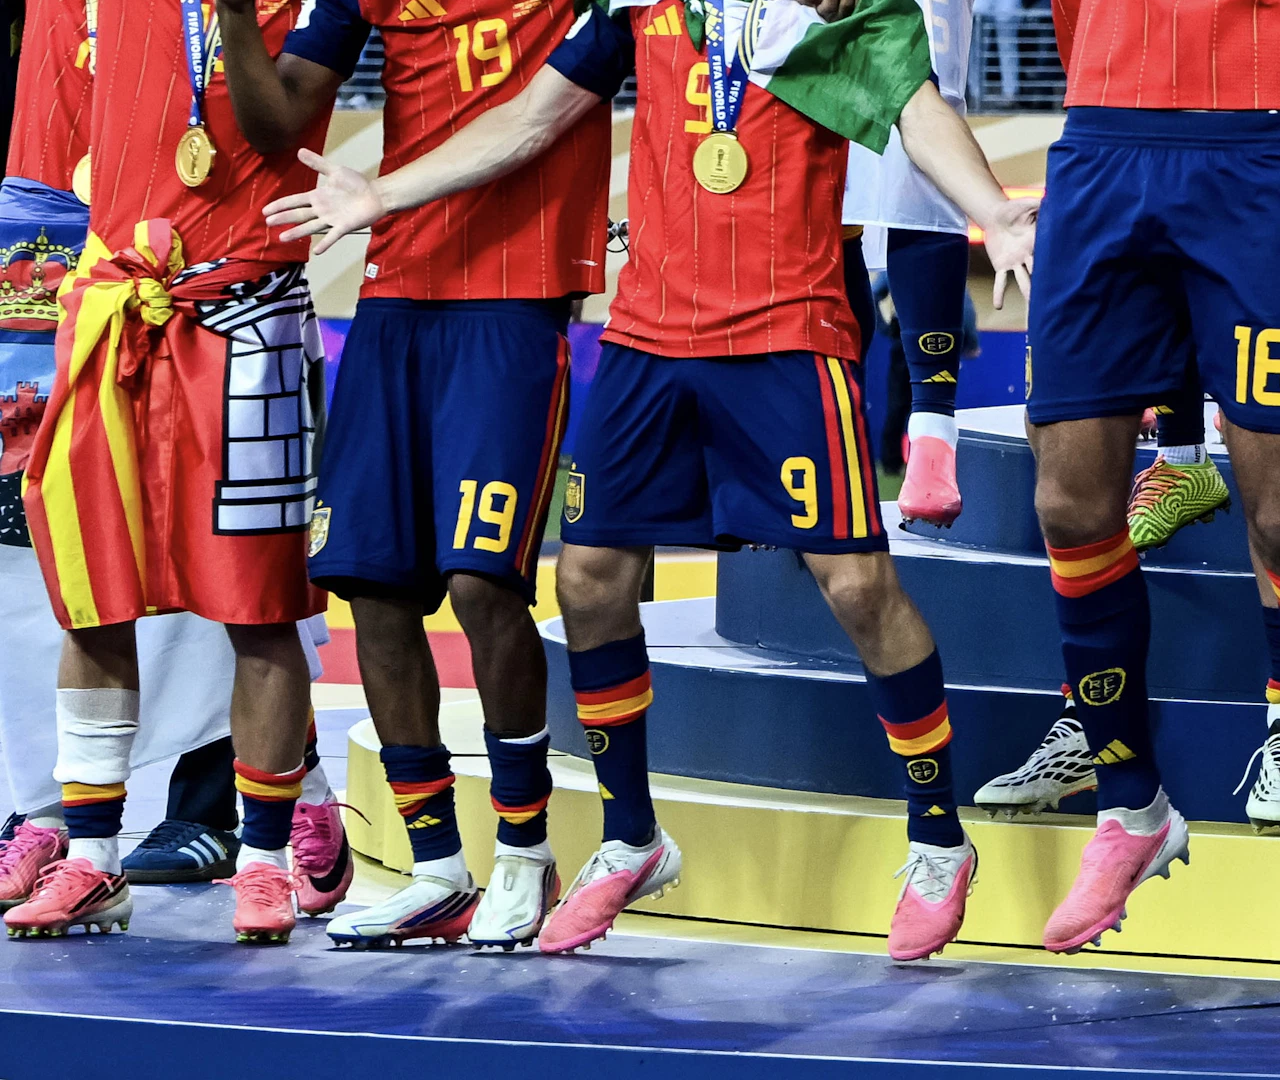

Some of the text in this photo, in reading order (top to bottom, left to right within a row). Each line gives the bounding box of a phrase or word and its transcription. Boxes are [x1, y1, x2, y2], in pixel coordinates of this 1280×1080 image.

[187, 11, 199, 35] FIFA
[190, 34, 203, 74] WORLD
[452, 17, 513, 93] 19
[712, 55, 724, 80] FIFA
[684, 61, 715, 135] 9
[713, 80, 727, 120] WORLD
[728, 80, 742, 104] FIFA
[780, 456, 819, 530] 9
[453, 480, 518, 554] 19
